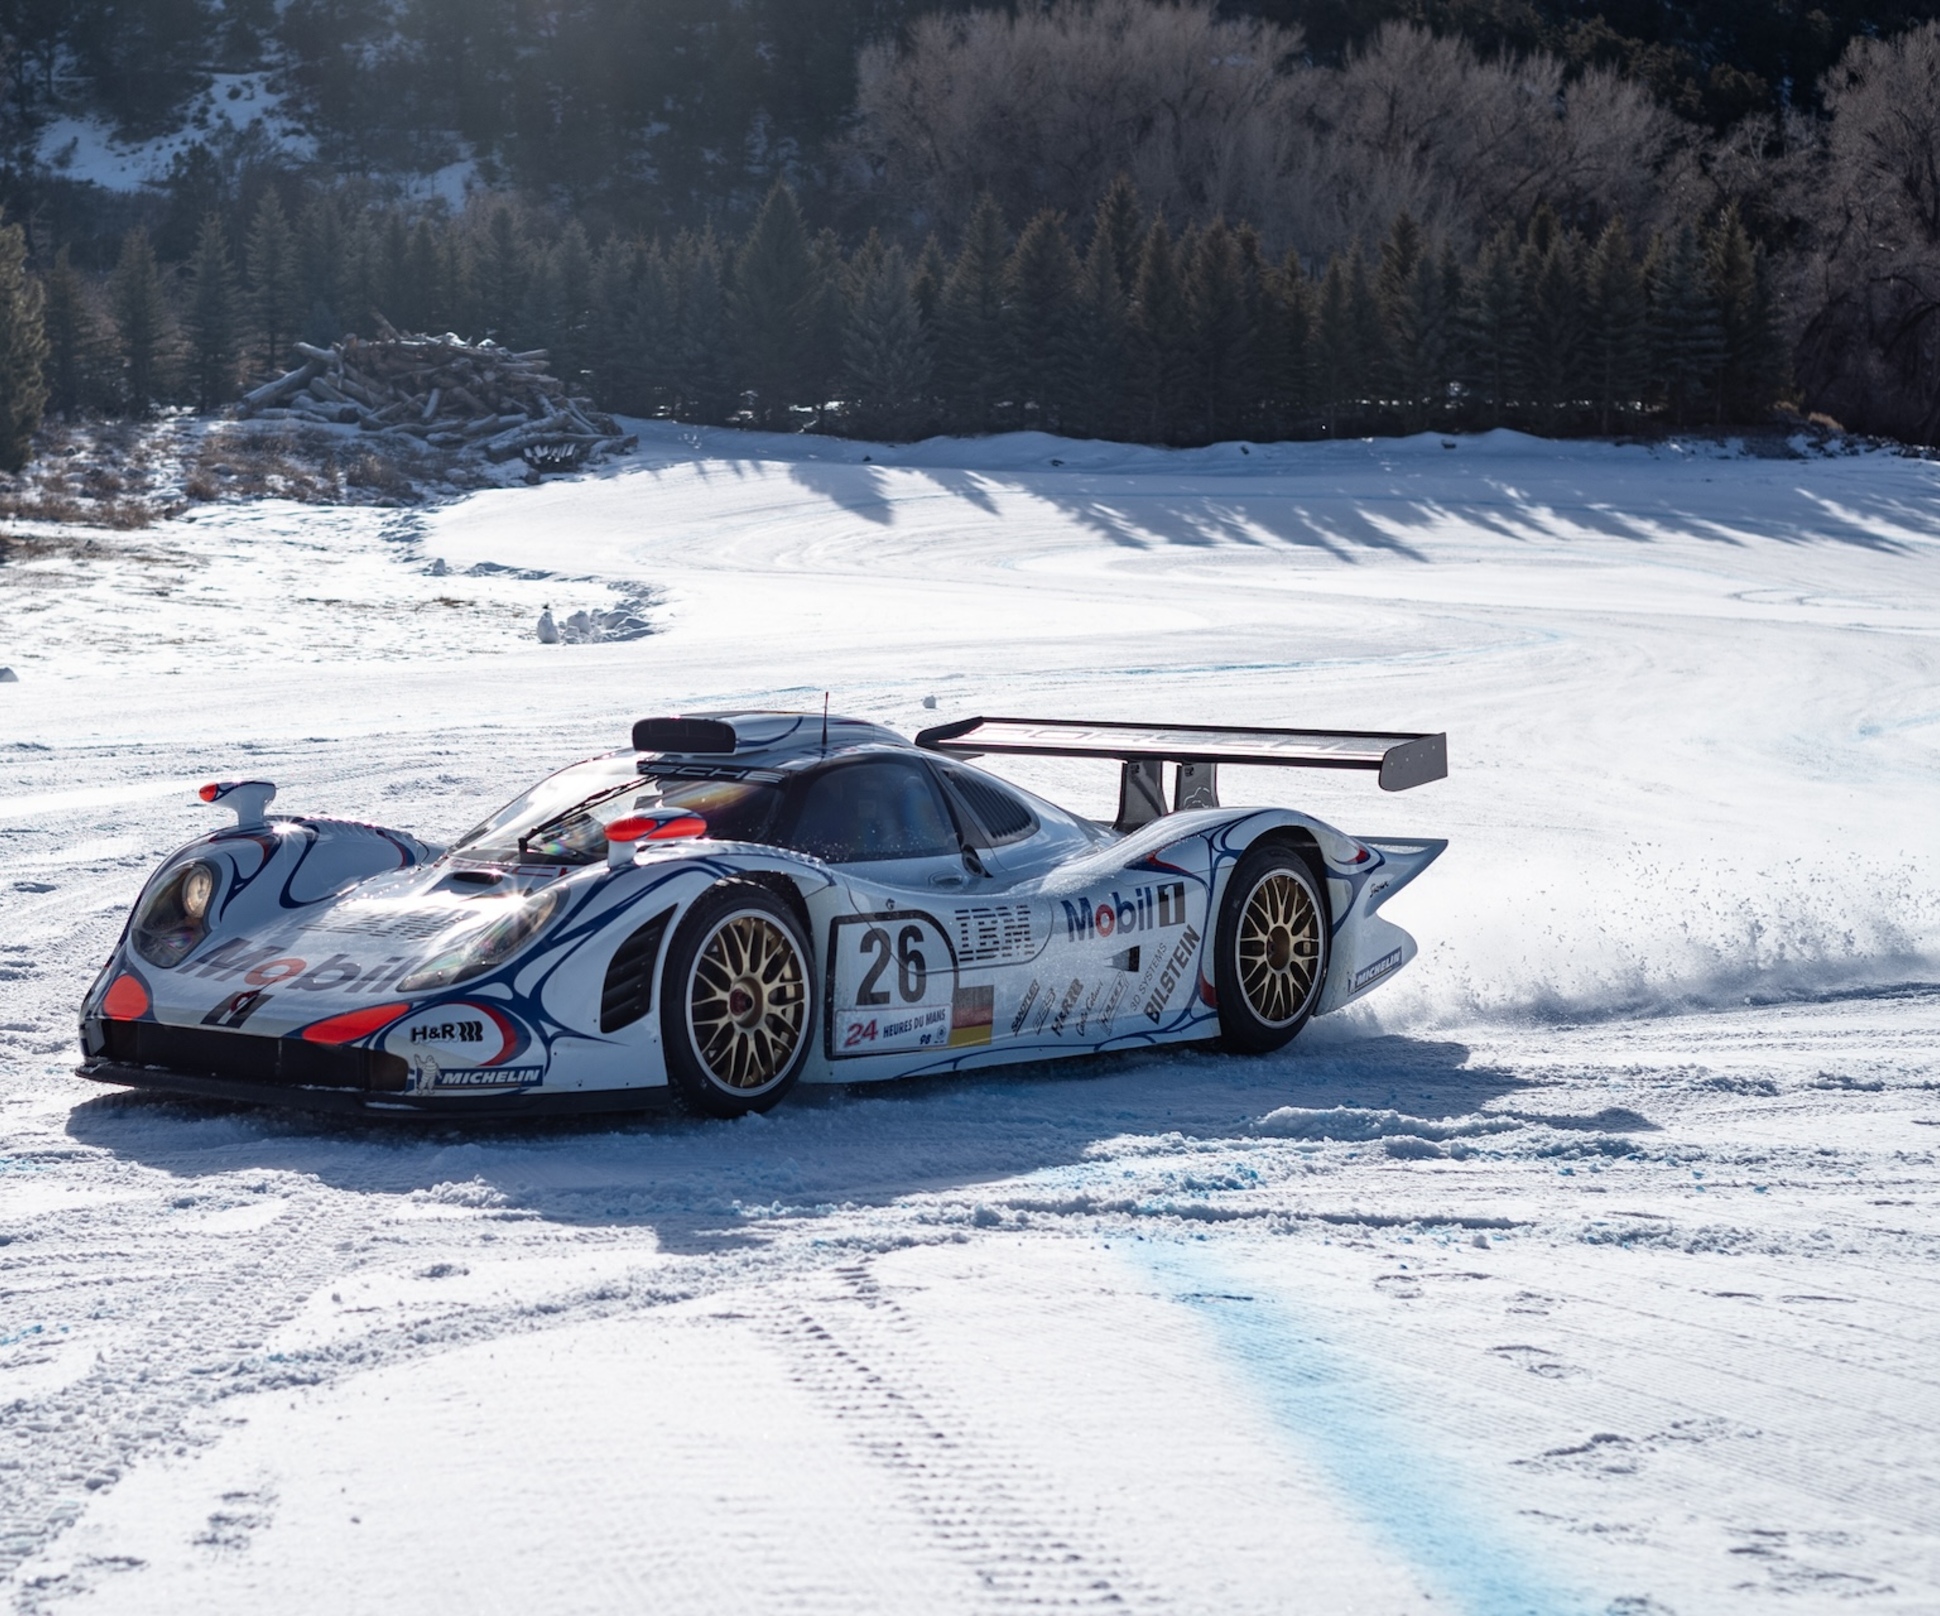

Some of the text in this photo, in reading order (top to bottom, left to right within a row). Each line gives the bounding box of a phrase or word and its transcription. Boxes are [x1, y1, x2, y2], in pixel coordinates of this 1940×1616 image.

[955, 905, 1035, 962] IBM
[1061, 887, 1154, 942] Mobil
[176, 937, 425, 993] Mobil
[856, 924, 927, 1005] 26
[1129, 942, 1168, 1011] 3D SYSTEMS
[1144, 924, 1201, 1025] BILSTEIN
[1357, 951, 1400, 985] MICHELIN
[411, 1023, 455, 1042] H&R
[845, 1009, 946, 1047] 24 HEURES DU MANS
[442, 1069, 540, 1084] MICHELIN
